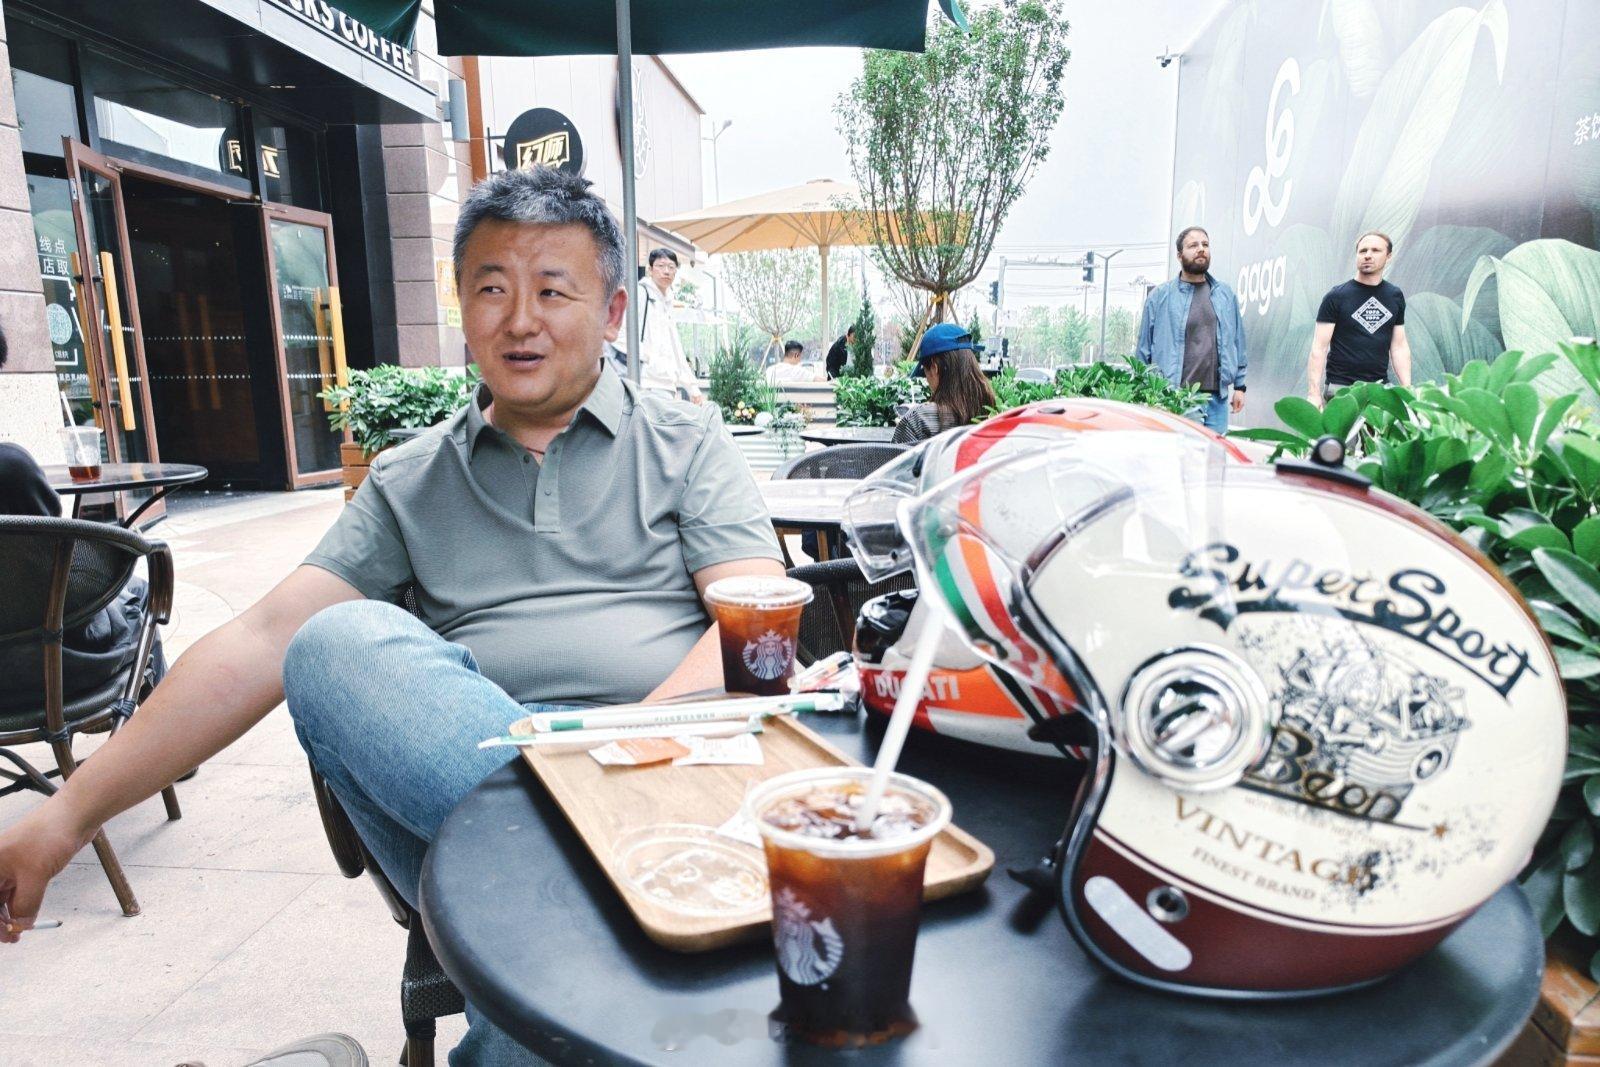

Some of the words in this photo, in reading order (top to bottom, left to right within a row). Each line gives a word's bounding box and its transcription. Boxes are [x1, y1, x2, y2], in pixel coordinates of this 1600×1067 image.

[339, 12, 414, 76] COFFEE
[39, 236, 66, 254] 线点
[43, 258, 70, 275] 店取
[1237, 255, 1287, 318] gaga
[873, 672, 961, 701] DUATI
[1248, 723, 1402, 821] Beon
[1193, 846, 1256, 882] FINEST
[1255, 871, 1316, 901] BRAND
